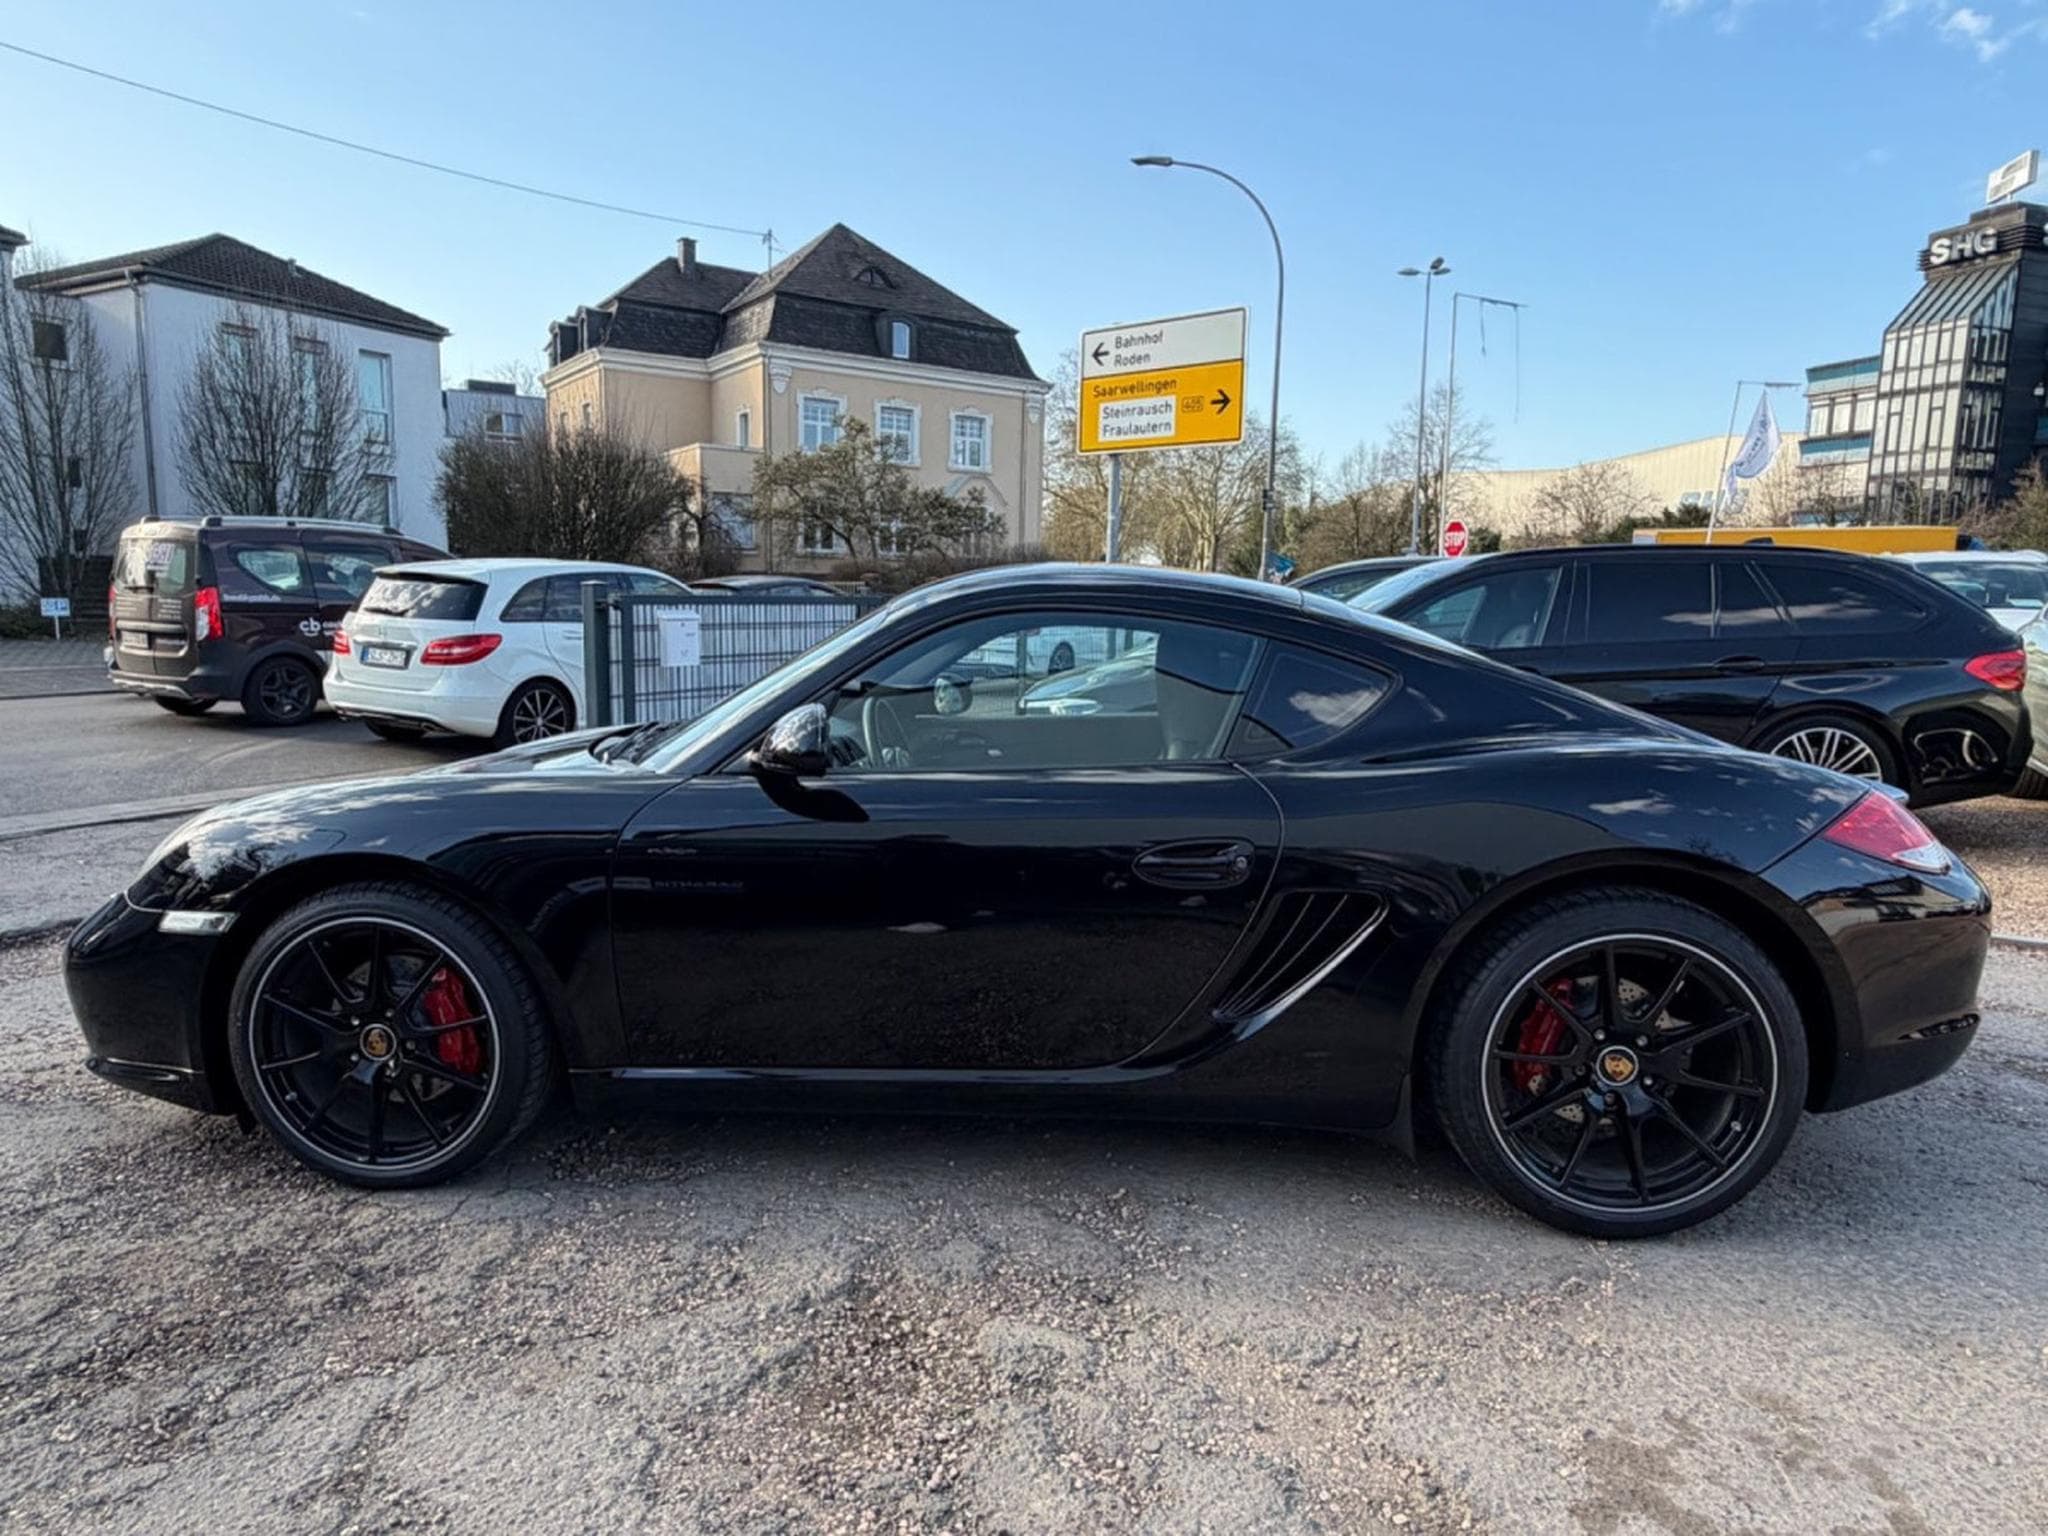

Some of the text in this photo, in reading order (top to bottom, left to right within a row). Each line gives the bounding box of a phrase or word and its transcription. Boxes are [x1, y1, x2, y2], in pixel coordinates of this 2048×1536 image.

[1929, 226, 1998, 265] SHG
[1114, 330, 1164, 349] Bahnhof
[1114, 352, 1151, 367] Roden
[1093, 378, 1177, 398] Saarwellingen
[1102, 401, 1173, 420] Steinrausch
[1102, 421, 1172, 437] Fraulautern
[1444, 531, 1465, 547] STOP
